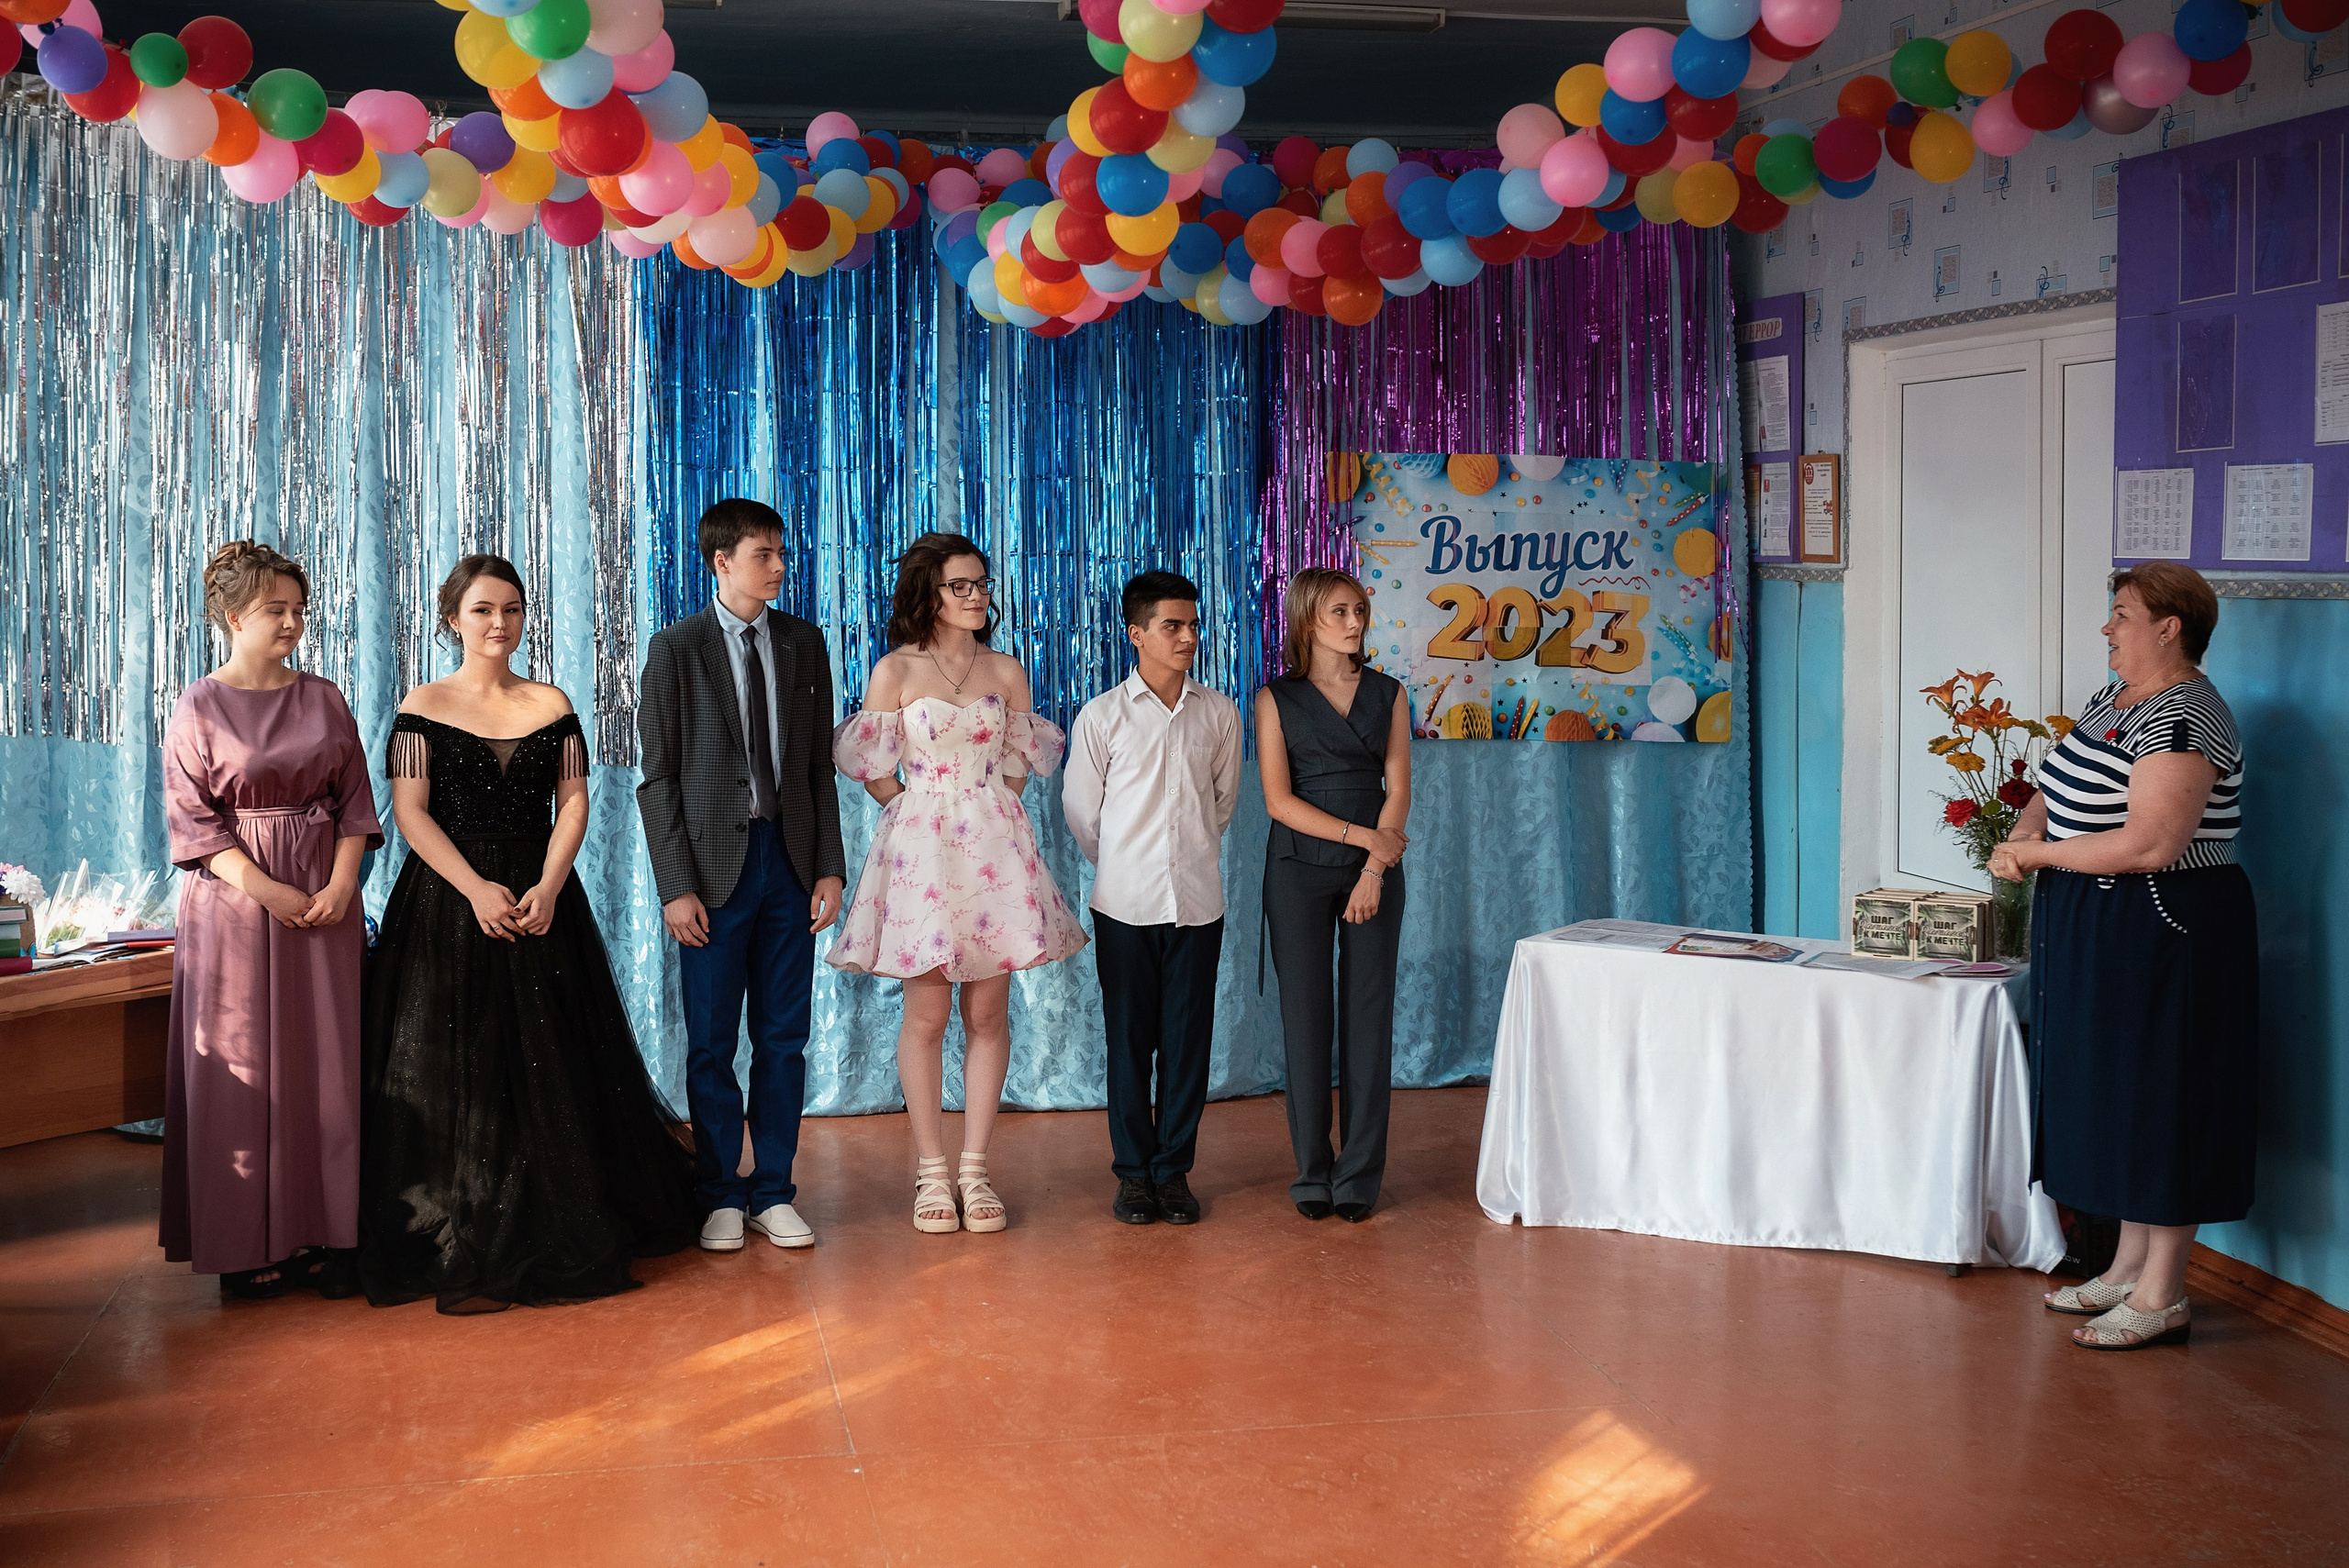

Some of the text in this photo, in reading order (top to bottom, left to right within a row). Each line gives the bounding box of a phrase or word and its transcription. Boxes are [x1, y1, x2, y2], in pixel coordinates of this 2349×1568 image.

[1805, 469, 1813, 477] 112
[1420, 515, 1634, 598] Выпуск
[1426, 583, 1650, 674] 2023
[1871, 916, 1895, 925] ШАГ
[1933, 921, 1957, 930] ШАГ
[1871, 930, 1901, 940] МЕЧТЕ
[1926, 936, 1964, 946] К МЕЧТЕ
